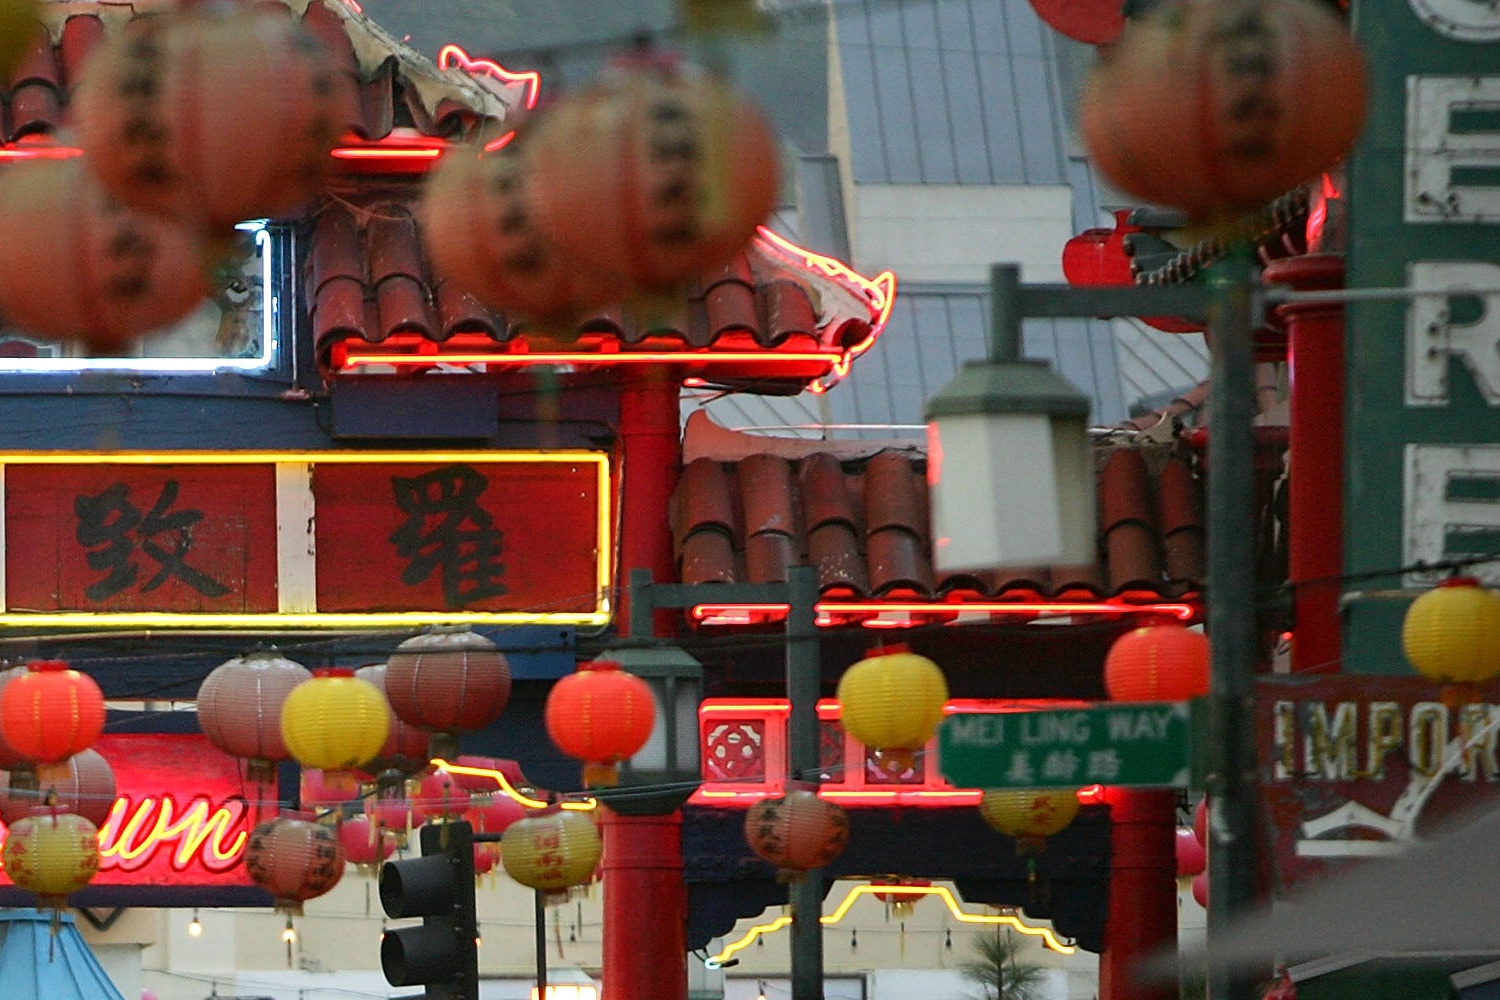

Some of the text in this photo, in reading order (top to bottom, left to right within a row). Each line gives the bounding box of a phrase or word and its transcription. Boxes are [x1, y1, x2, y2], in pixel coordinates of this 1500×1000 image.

[951, 709, 1174, 745] MEI LING WAY
